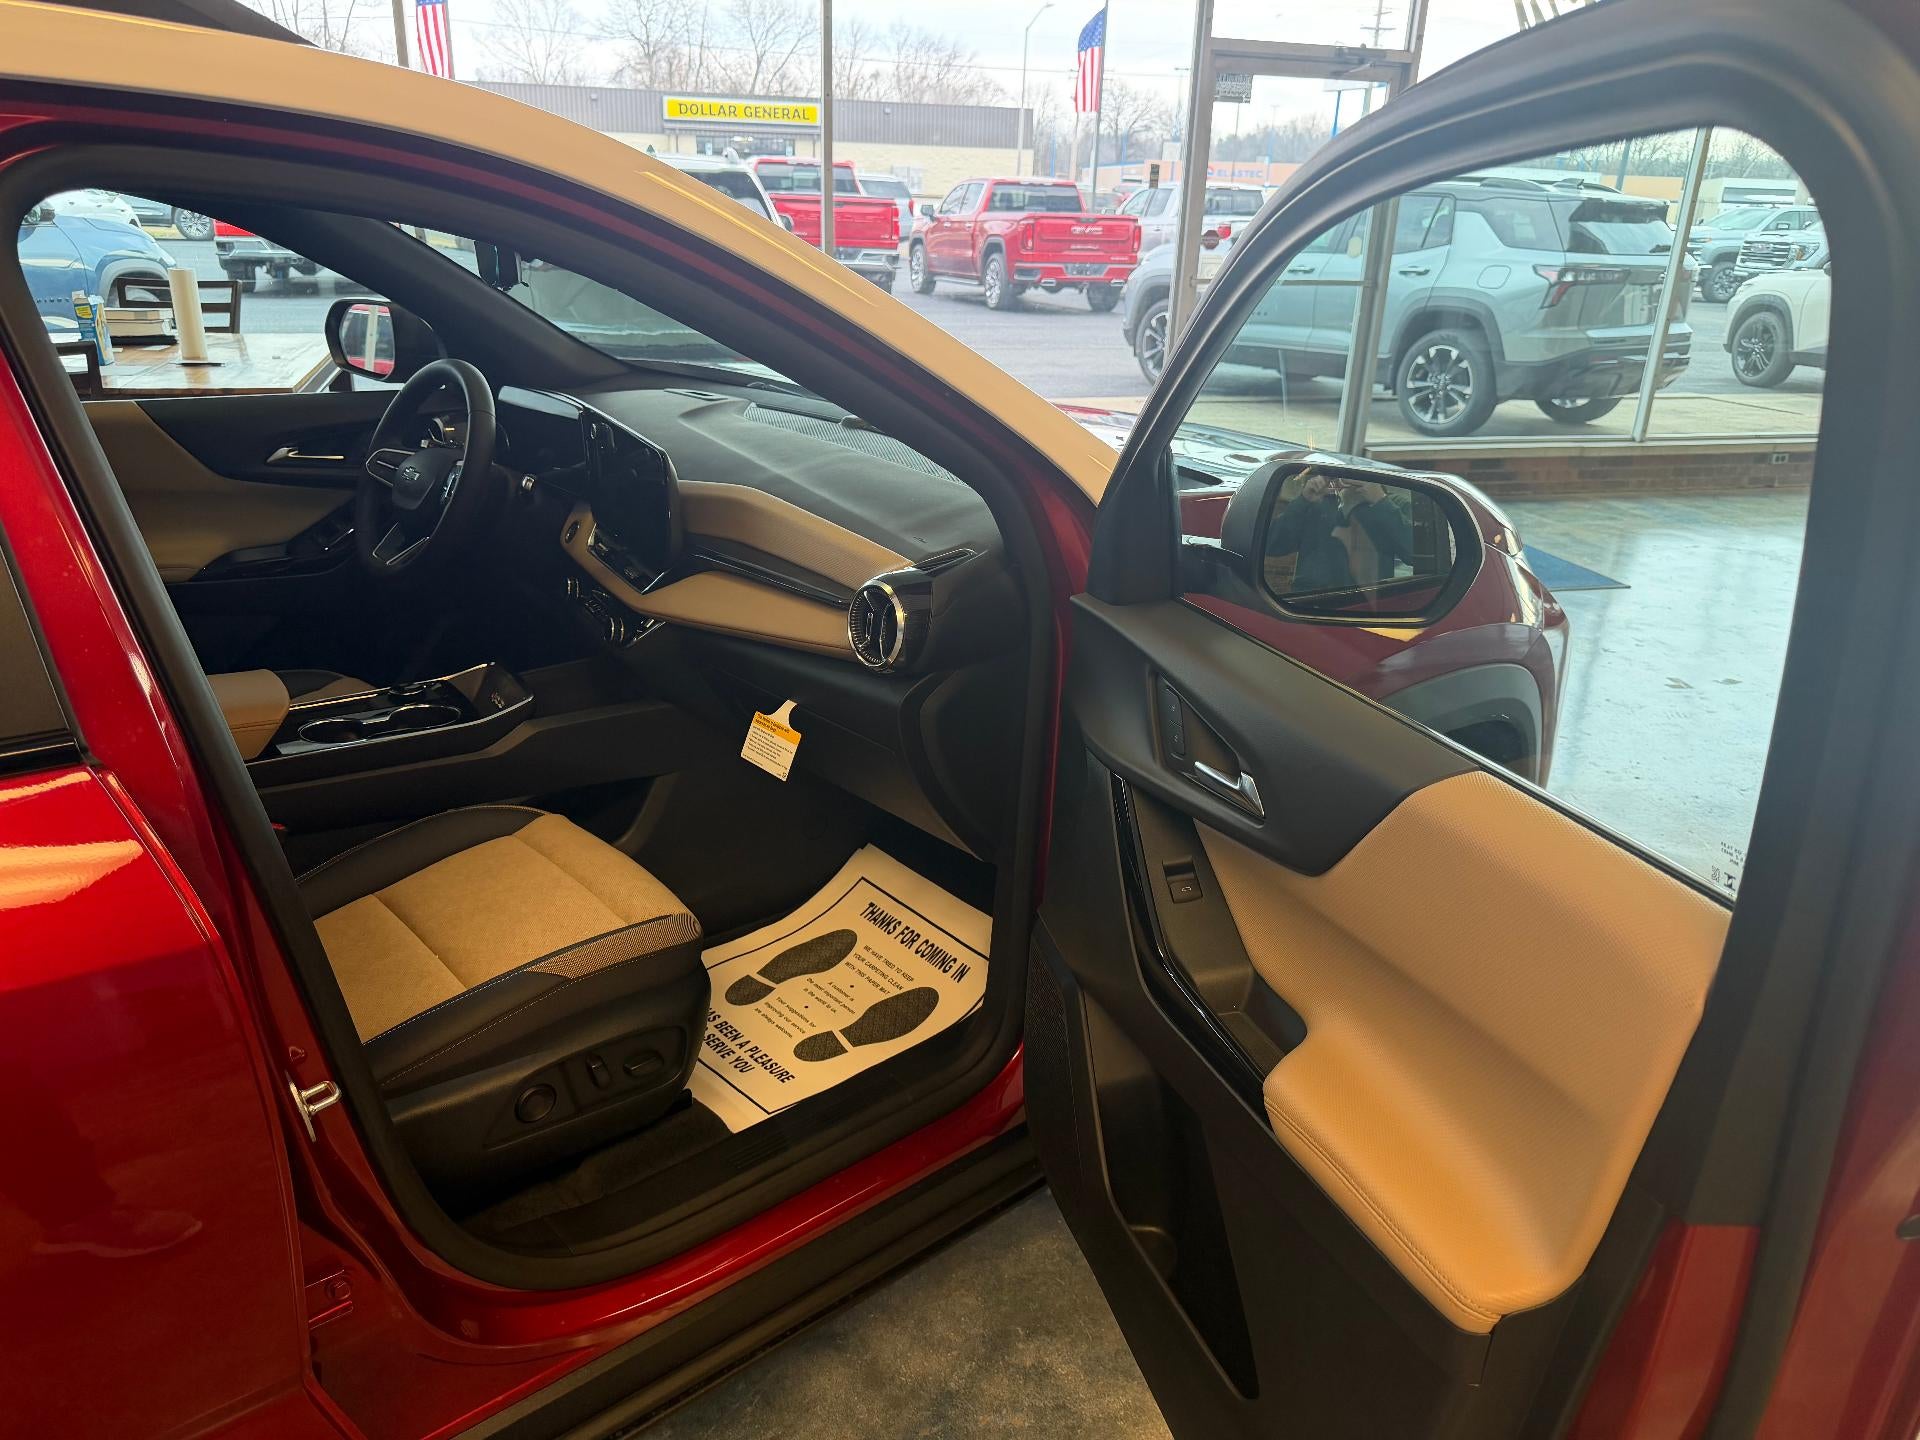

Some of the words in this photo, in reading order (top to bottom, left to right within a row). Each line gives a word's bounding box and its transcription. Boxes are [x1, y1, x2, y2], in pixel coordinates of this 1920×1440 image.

[678, 103, 738, 118] DOLLAR
[743, 106, 810, 121] GENERAL
[860, 902, 902, 935] THANKS
[894, 925, 921, 950] FOR
[914, 939, 958, 974] COMING
[950, 962, 971, 984] IN
[845, 961, 856, 970] WITH
[855, 968, 866, 978] THIS
[865, 976, 880, 988] PAPER
[879, 986, 891, 995] MAT
[853, 952, 866, 963] YOUR
[864, 961, 889, 979] CARPETING
[887, 977, 904, 991] CLEAN
[871, 951, 883, 960] HAVE
[882, 958, 896, 969] TRIED
[902, 972, 914, 982] KEEP
[813, 983, 824, 991] most
[823, 990, 843, 1004] important
[832, 984, 850, 998] customer
[785, 1004, 809, 1023] suggestions
[791, 1022, 805, 1034] service
[704, 1033, 736, 1058] SERVE
[729, 1055, 756, 1074] YOU
[713, 1020, 744, 1042] BEEN
[735, 1040, 751, 1050] A
[743, 1045, 796, 1084] PLEASURE
